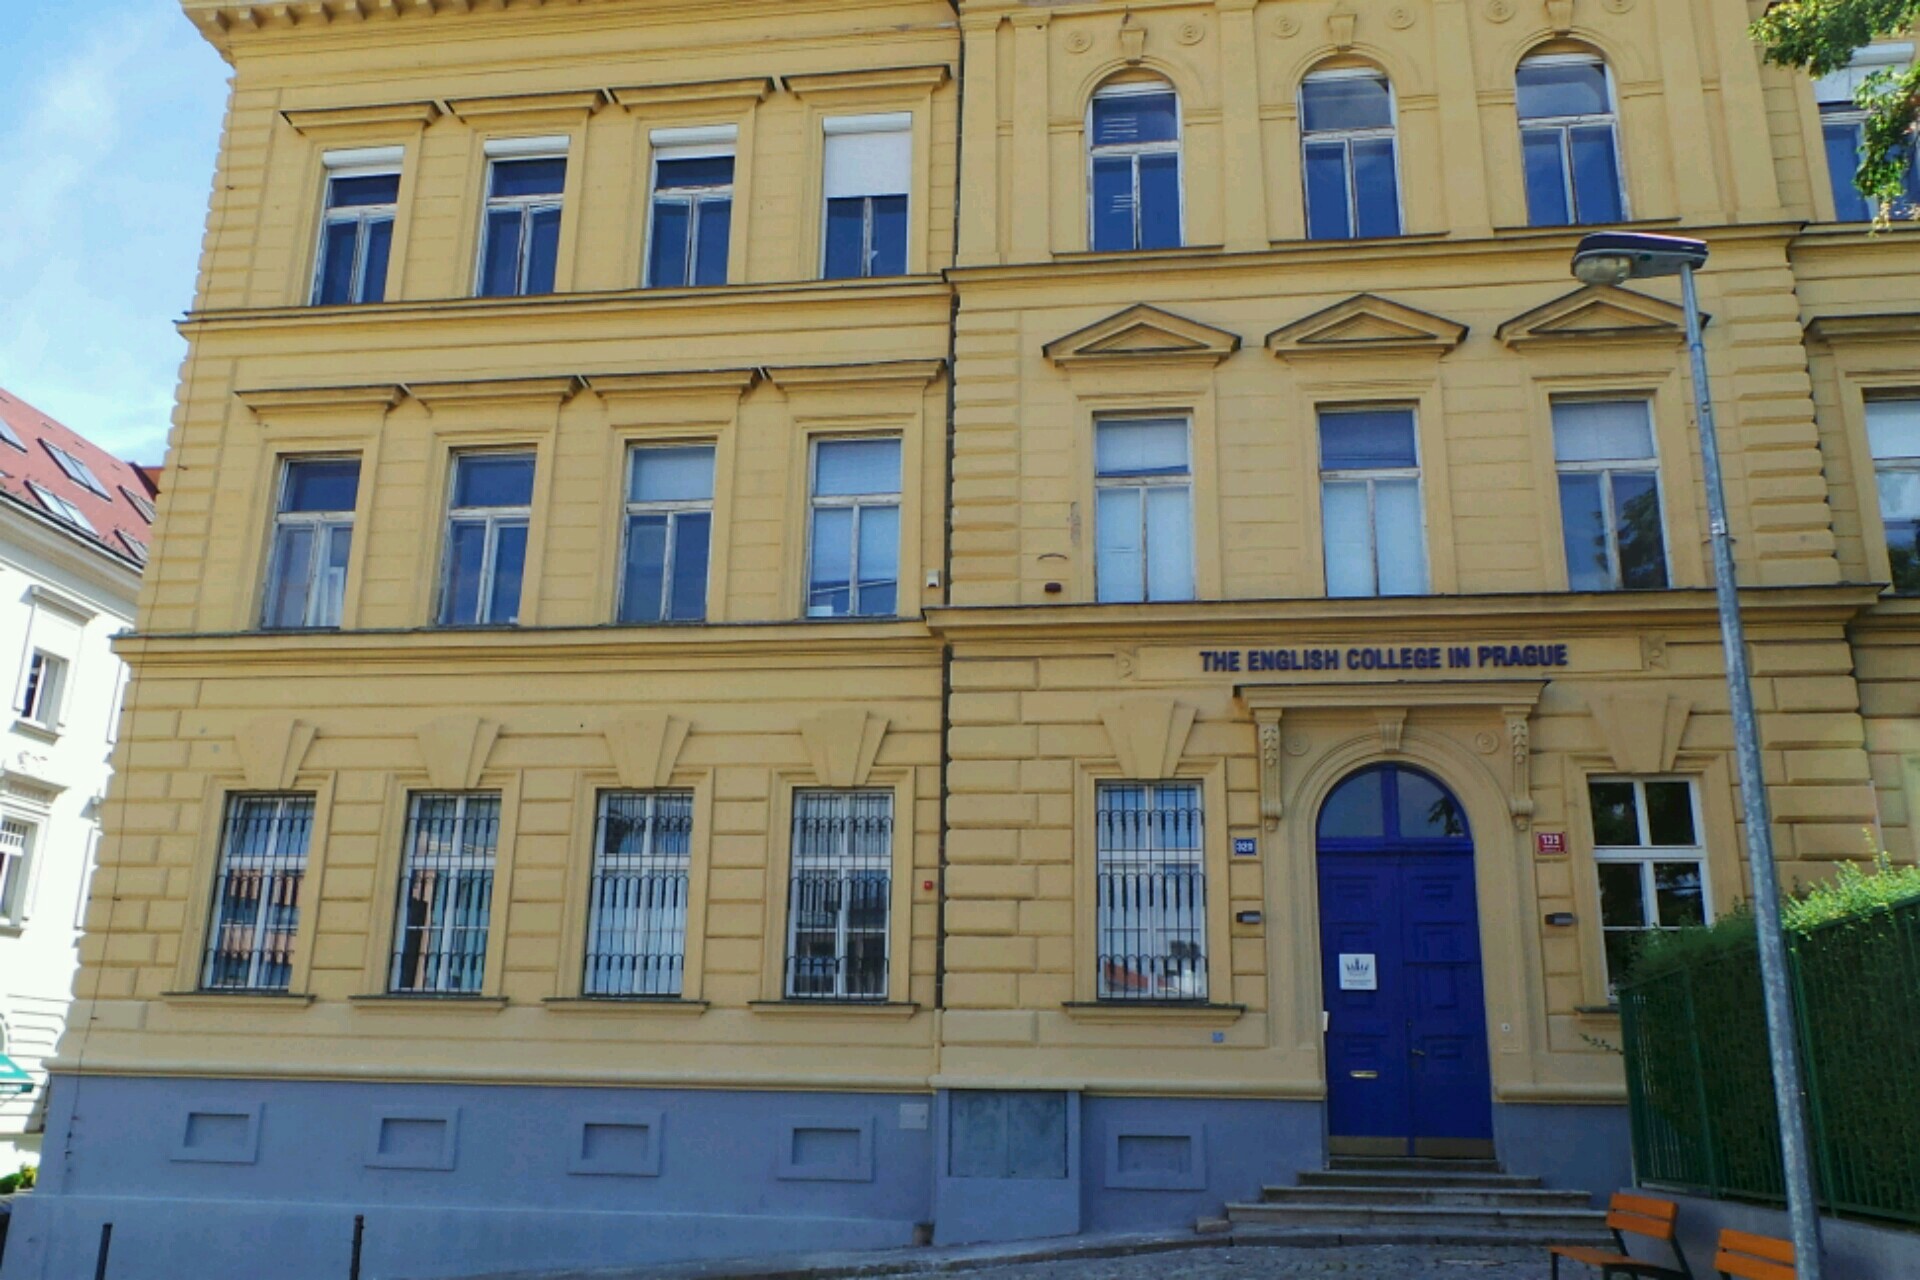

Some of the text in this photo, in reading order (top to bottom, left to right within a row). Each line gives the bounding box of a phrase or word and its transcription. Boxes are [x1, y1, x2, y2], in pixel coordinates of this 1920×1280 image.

[1200, 644, 1567, 671] THE ENGLISH COLLEGE IN PRAGUE
